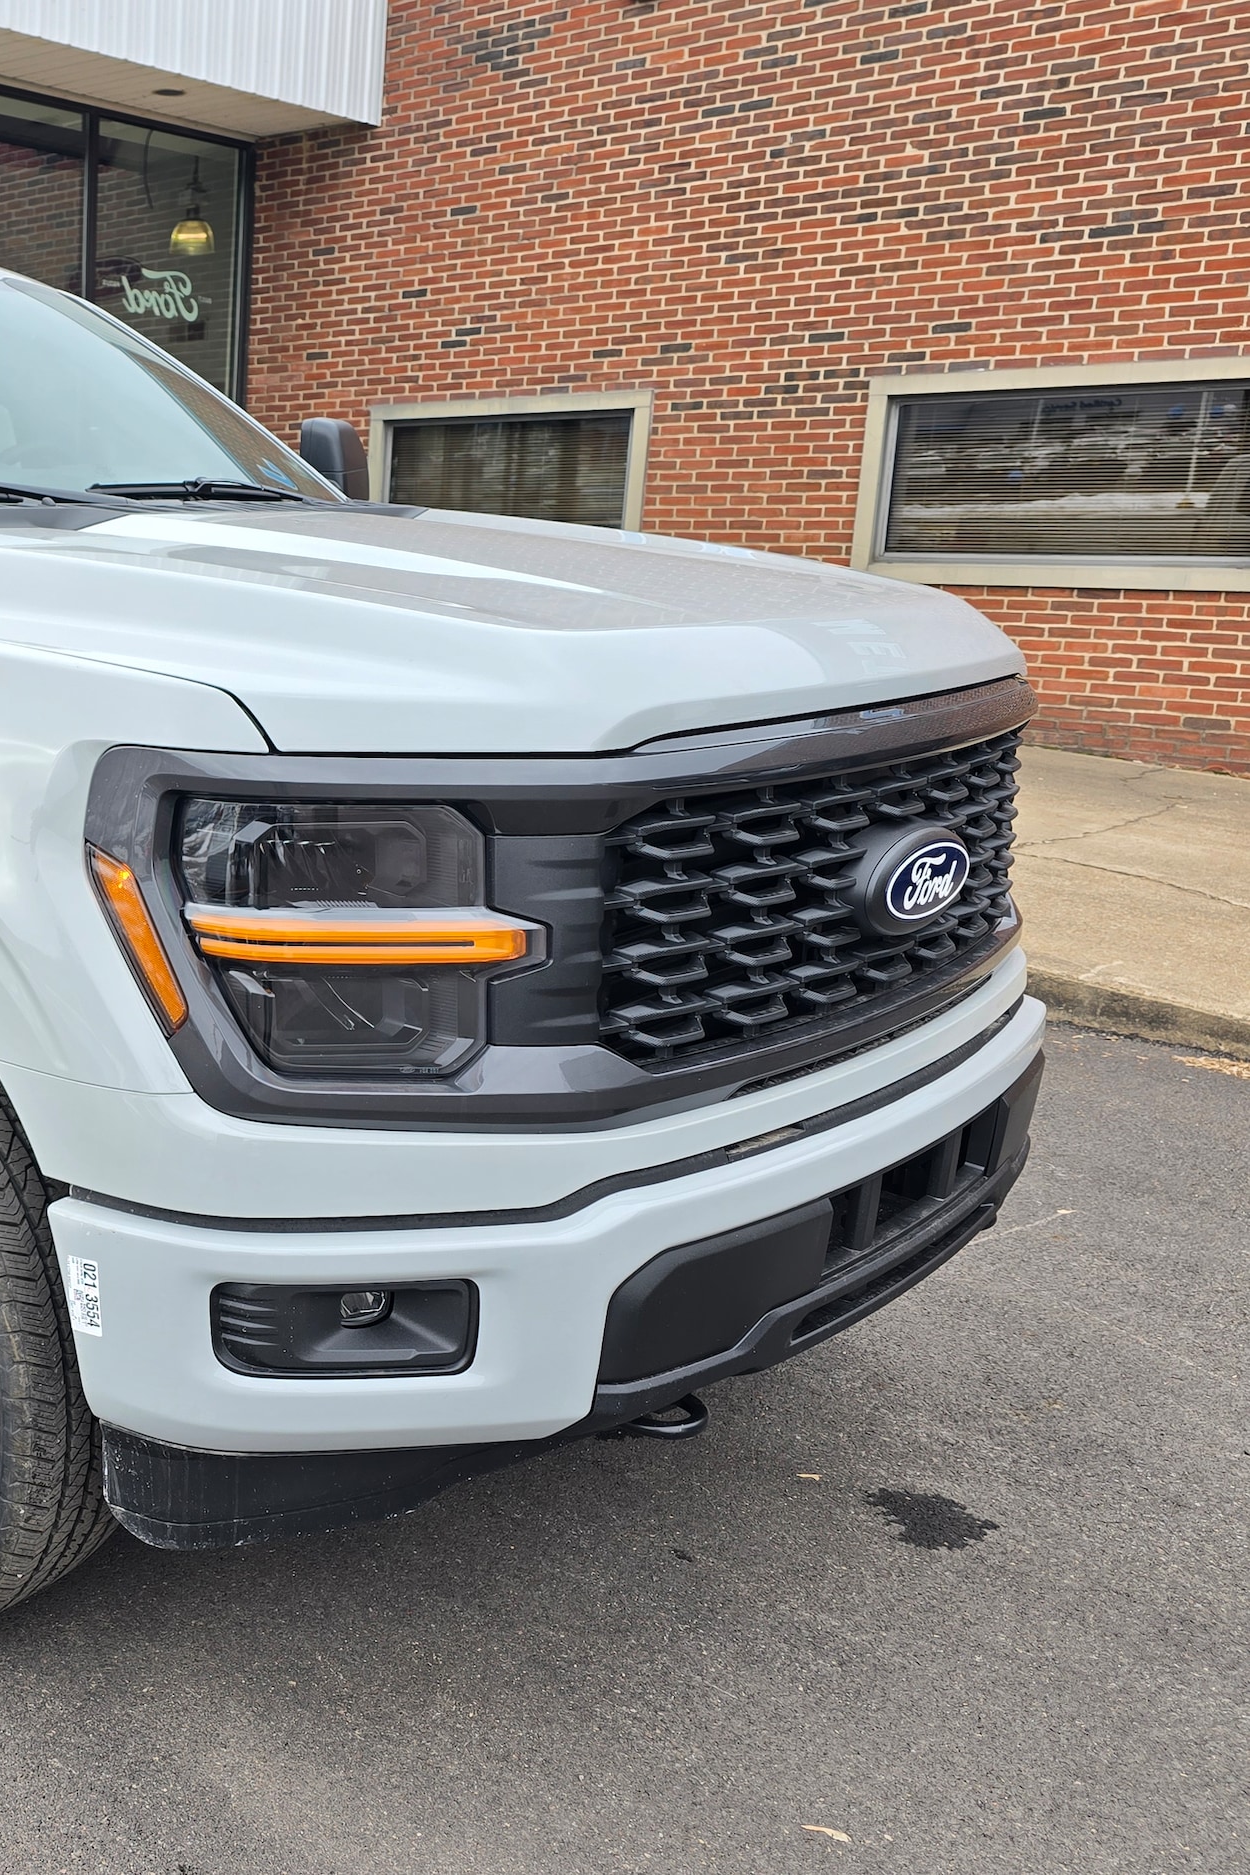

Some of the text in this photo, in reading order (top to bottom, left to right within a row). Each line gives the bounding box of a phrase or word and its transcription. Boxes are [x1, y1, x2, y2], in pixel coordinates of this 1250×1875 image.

[902, 852, 958, 911] Ford
[82, 1262, 101, 1328] 021 3554
